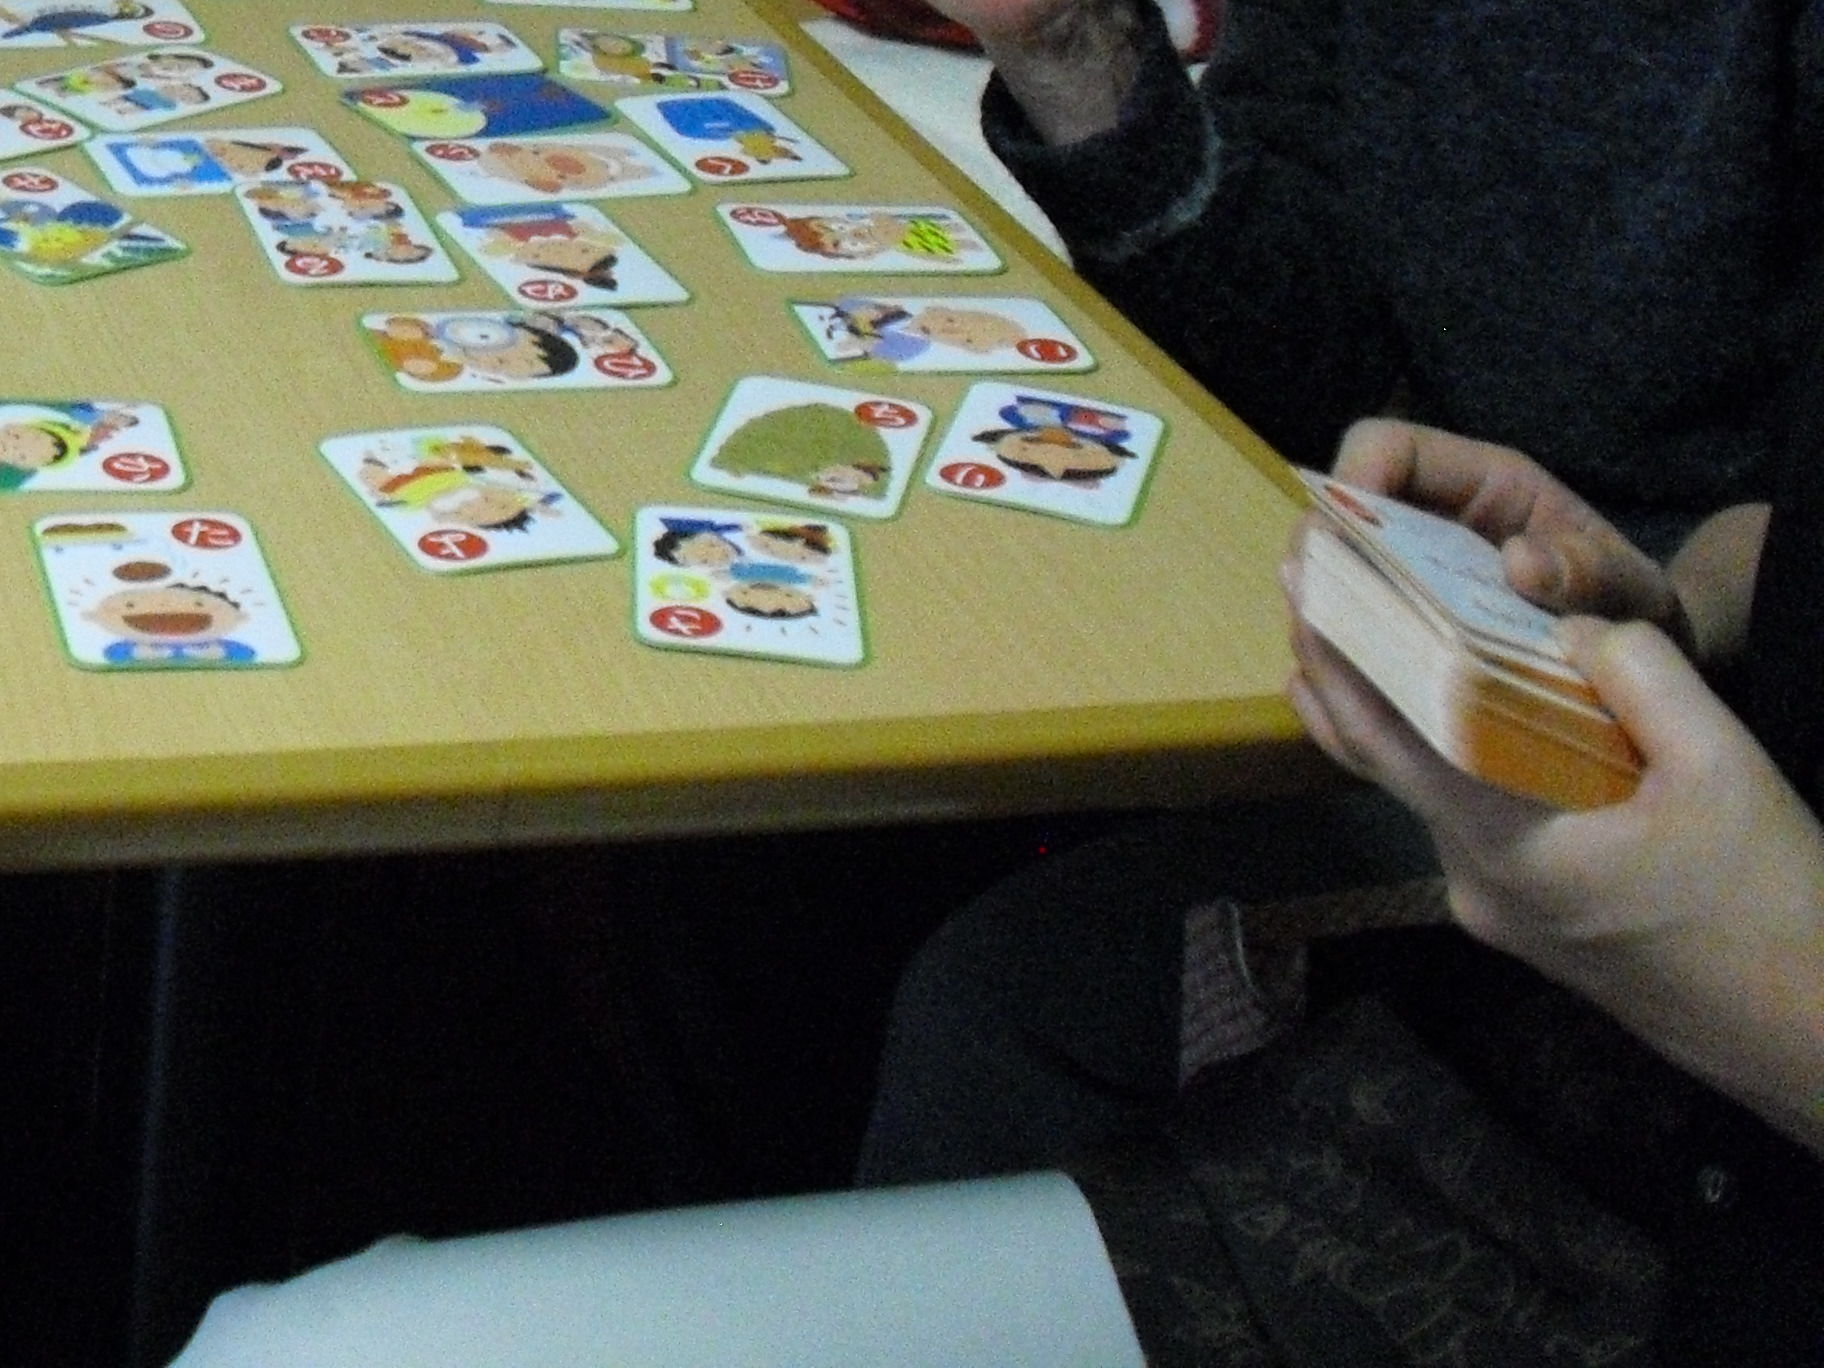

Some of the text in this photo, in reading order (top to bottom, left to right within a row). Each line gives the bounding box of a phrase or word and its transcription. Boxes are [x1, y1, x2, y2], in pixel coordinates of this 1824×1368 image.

[1020, 342, 1071, 359] こ
[598, 355, 652, 377] ひ
[867, 402, 908, 426] ち
[110, 454, 166, 482] か
[953, 463, 987, 487] り
[180, 519, 237, 547] た
[427, 533, 480, 560] よ
